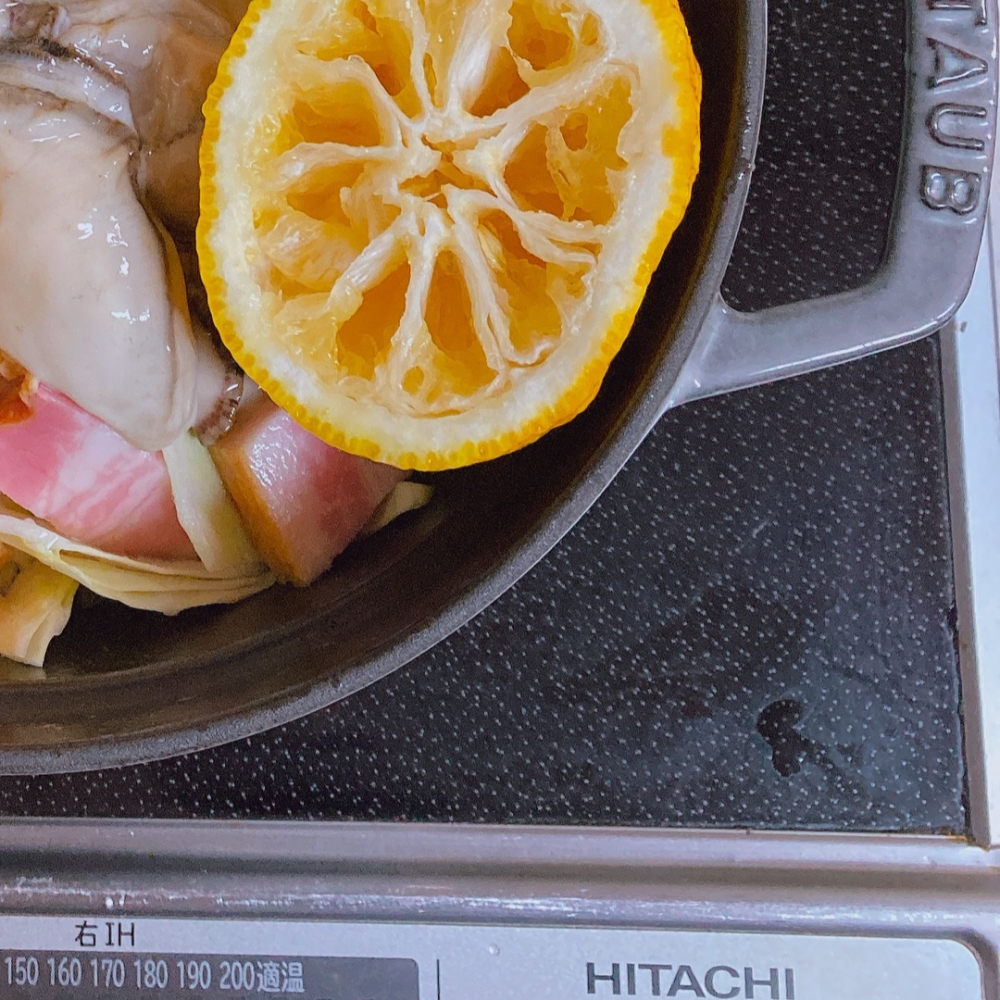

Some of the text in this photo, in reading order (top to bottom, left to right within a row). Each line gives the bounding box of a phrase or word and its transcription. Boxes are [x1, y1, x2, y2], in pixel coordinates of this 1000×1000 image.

[4, 956, 39, 985] 150
[47, 956, 82, 986] 160
[90, 957, 125, 988] 170
[133, 959, 168, 988] 180
[177, 960, 211, 990] 190
[586, 962, 795, 999] HITACHI
